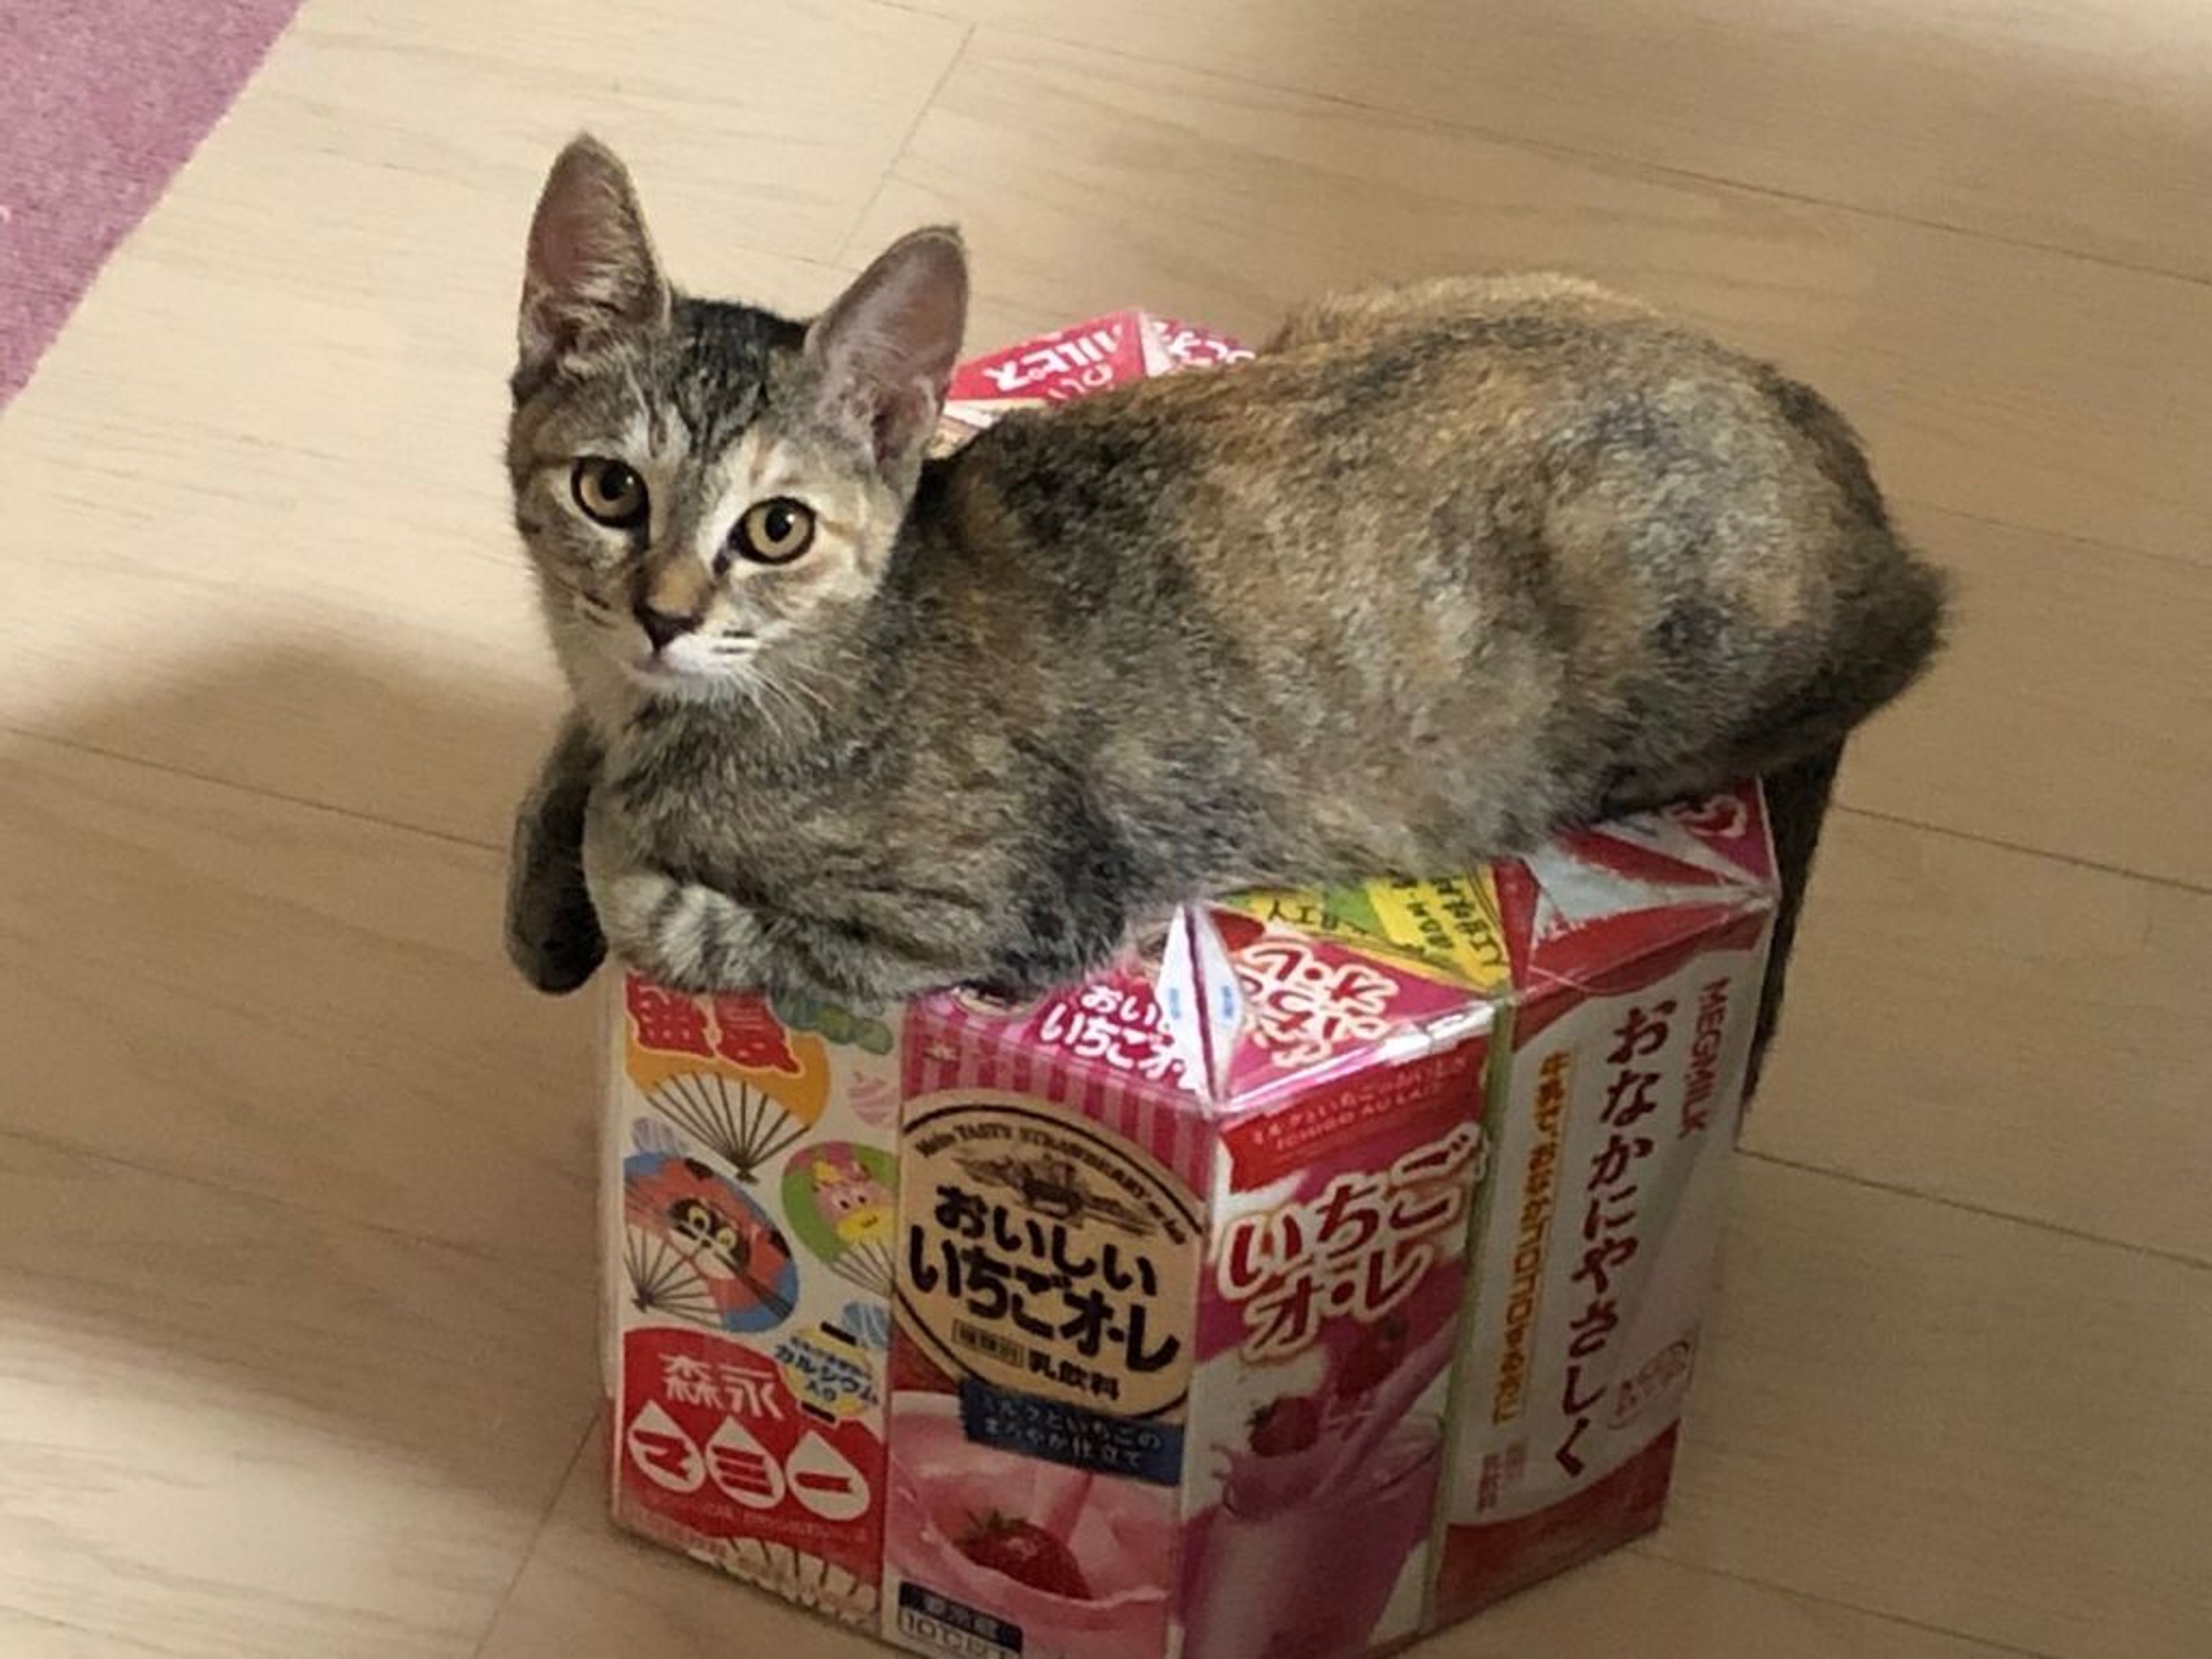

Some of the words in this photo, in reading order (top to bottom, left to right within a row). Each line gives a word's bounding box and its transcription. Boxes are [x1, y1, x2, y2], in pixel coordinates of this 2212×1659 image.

[1679, 977, 1730, 1138] MEGMILK
[934, 1184, 1157, 1296] おいしい
[1222, 1124, 1481, 1297] いちご
[1556, 1000, 1676, 1476] おなかにやさしく
[658, 1354, 786, 1422] 森永
[774, 1343, 880, 1406] カルシウム
[1028, 1348, 1120, 1400] 乳飲料
[632, 1427, 854, 1498] マミー
